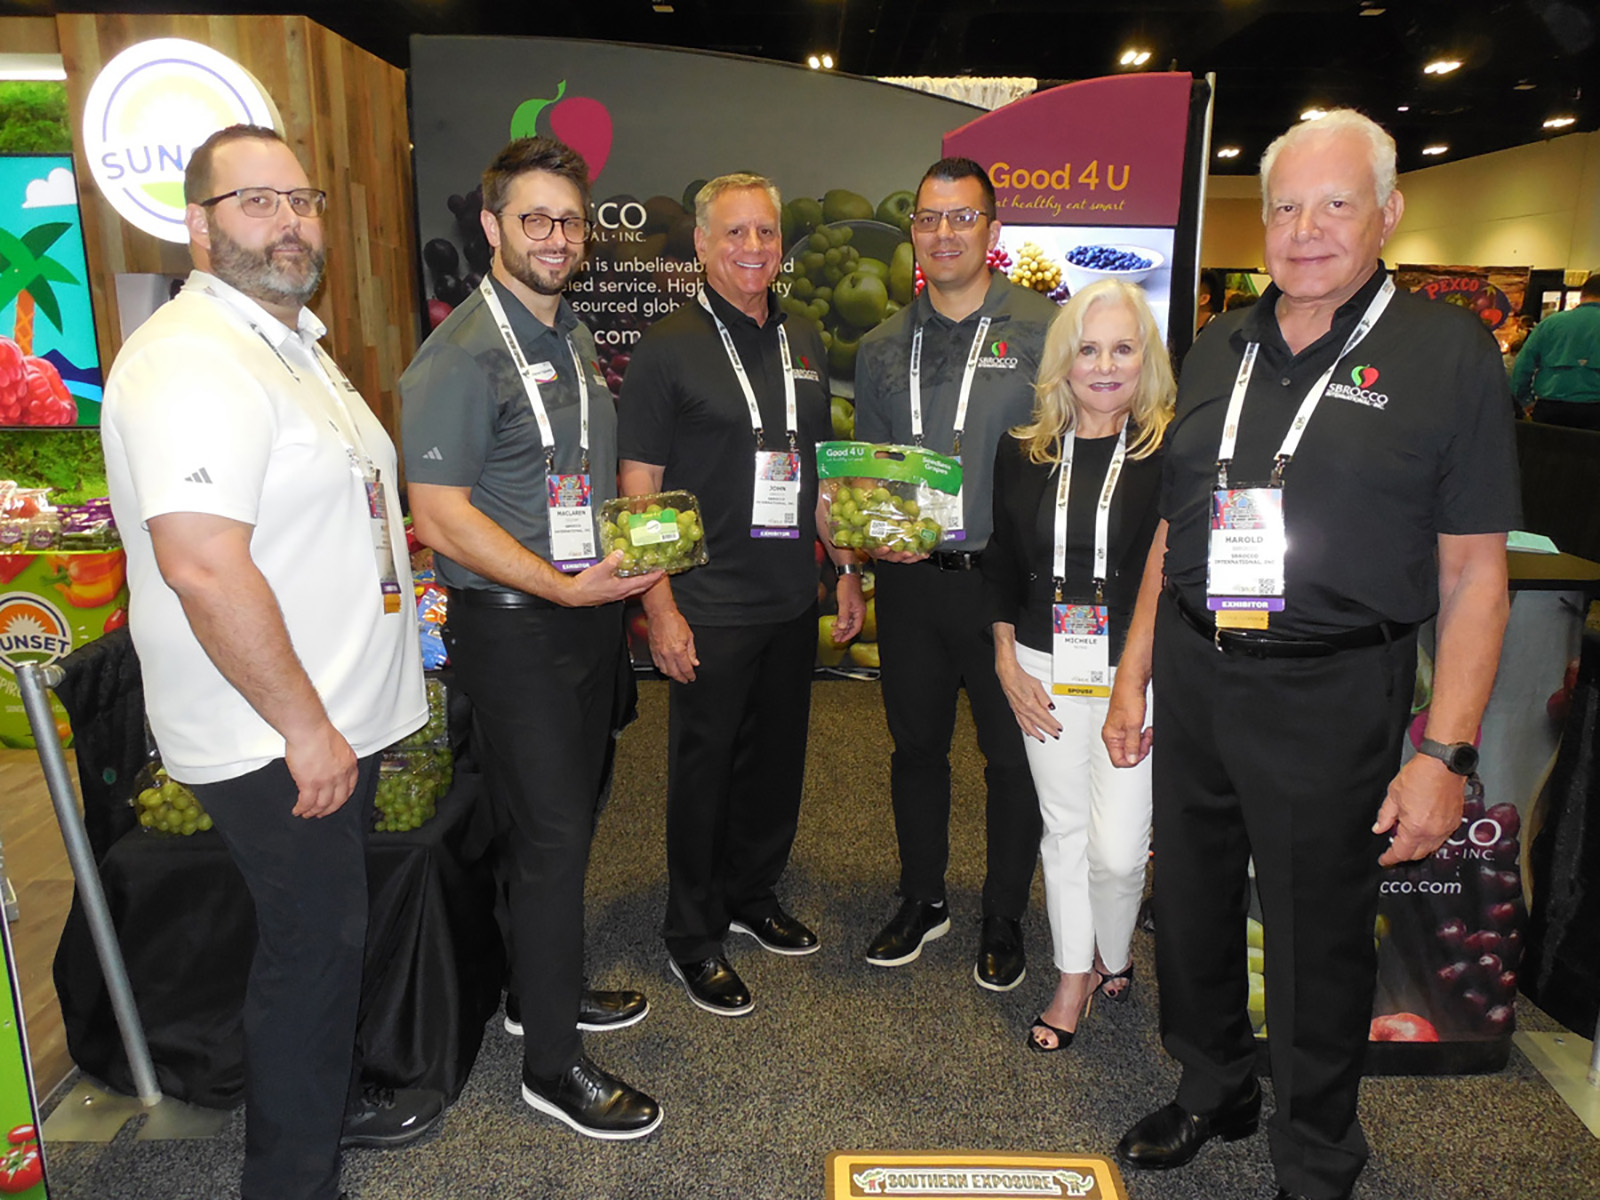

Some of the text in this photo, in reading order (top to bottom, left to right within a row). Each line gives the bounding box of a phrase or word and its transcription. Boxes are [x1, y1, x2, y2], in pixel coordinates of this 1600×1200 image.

[101, 144, 185, 180] SUN
[988, 160, 1131, 191] Good 4 U
[591, 201, 647, 229] CO
[1011, 195, 1061, 216] healthy
[1089, 200, 1126, 211] smart
[590, 231, 647, 242] AL INC.
[595, 256, 609, 272] is
[599, 277, 662, 293] service.
[769, 279, 792, 298] ity
[1425, 278, 1479, 300] PEXCO
[572, 297, 686, 317] sourced glob
[1329, 382, 1389, 405] SBROCCO
[826, 447, 865, 457] Good 4 U
[1225, 536, 1264, 544] HAROLD
[1221, 601, 1269, 609] EXHIBITOR
[0, 634, 70, 654] UNSET
[1064, 637, 1098, 645] MICHELE
[1463, 848, 1496, 861] INC.
[887, 1174, 1053, 1190] SOUTHERN EXPOSURE
